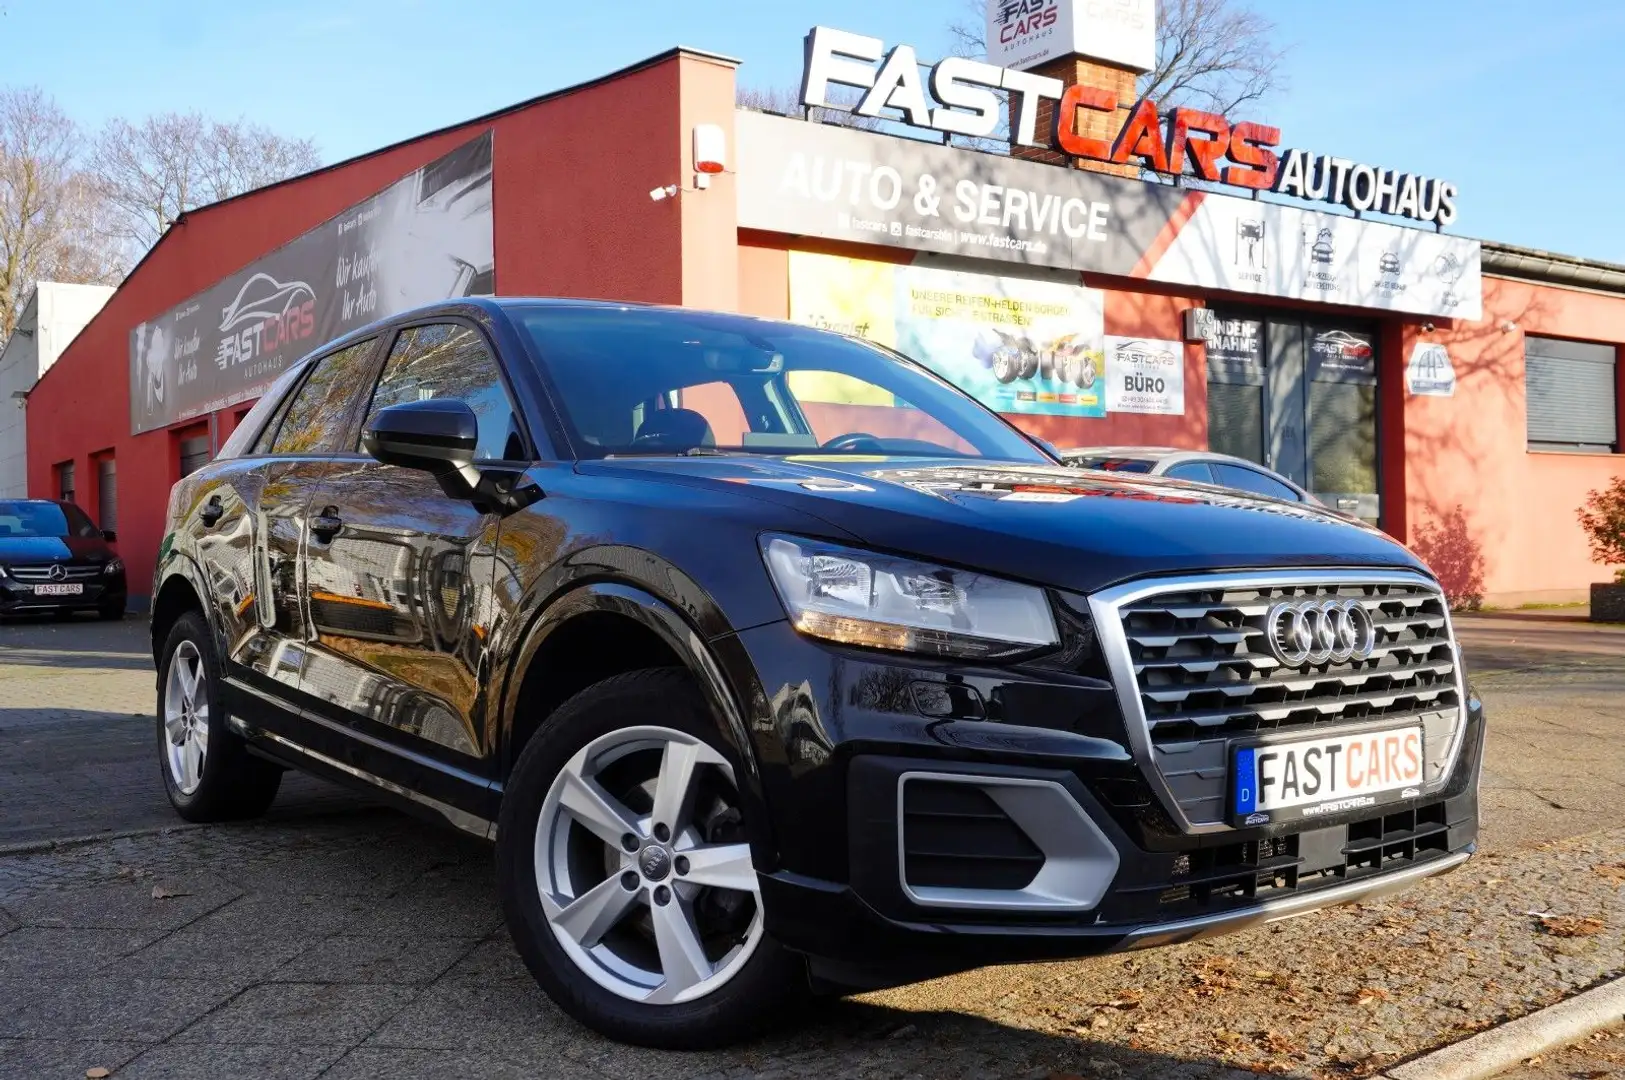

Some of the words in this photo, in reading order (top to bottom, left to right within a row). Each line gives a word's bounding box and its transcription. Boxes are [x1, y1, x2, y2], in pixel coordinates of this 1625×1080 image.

[1000, 5, 1058, 44] CARS
[1004, 28, 1053, 52] AUTOHAUS
[777, 152, 902, 211] AUTO
[913, 173, 940, 217] &
[954, 179, 1110, 242] SERVICE
[1278, 149, 1459, 227] AUTOHAUS
[960, 231, 1047, 254] www.fastcars.de
[356, 281, 377, 316] Auto
[911, 289, 954, 304] UNSERE
[955, 294, 1033, 313] REIFEN-HELDEN
[214, 297, 315, 371] FASTCARS
[1213, 320, 1257, 338] NDEN-
[1205, 335, 1258, 353] NNAHME
[243, 354, 283, 379] AUTOHAUS
[1112, 352, 1175, 366] FASTCARS
[1124, 371, 1165, 393] BÜRO
[1241, 788, 1250, 802] D
